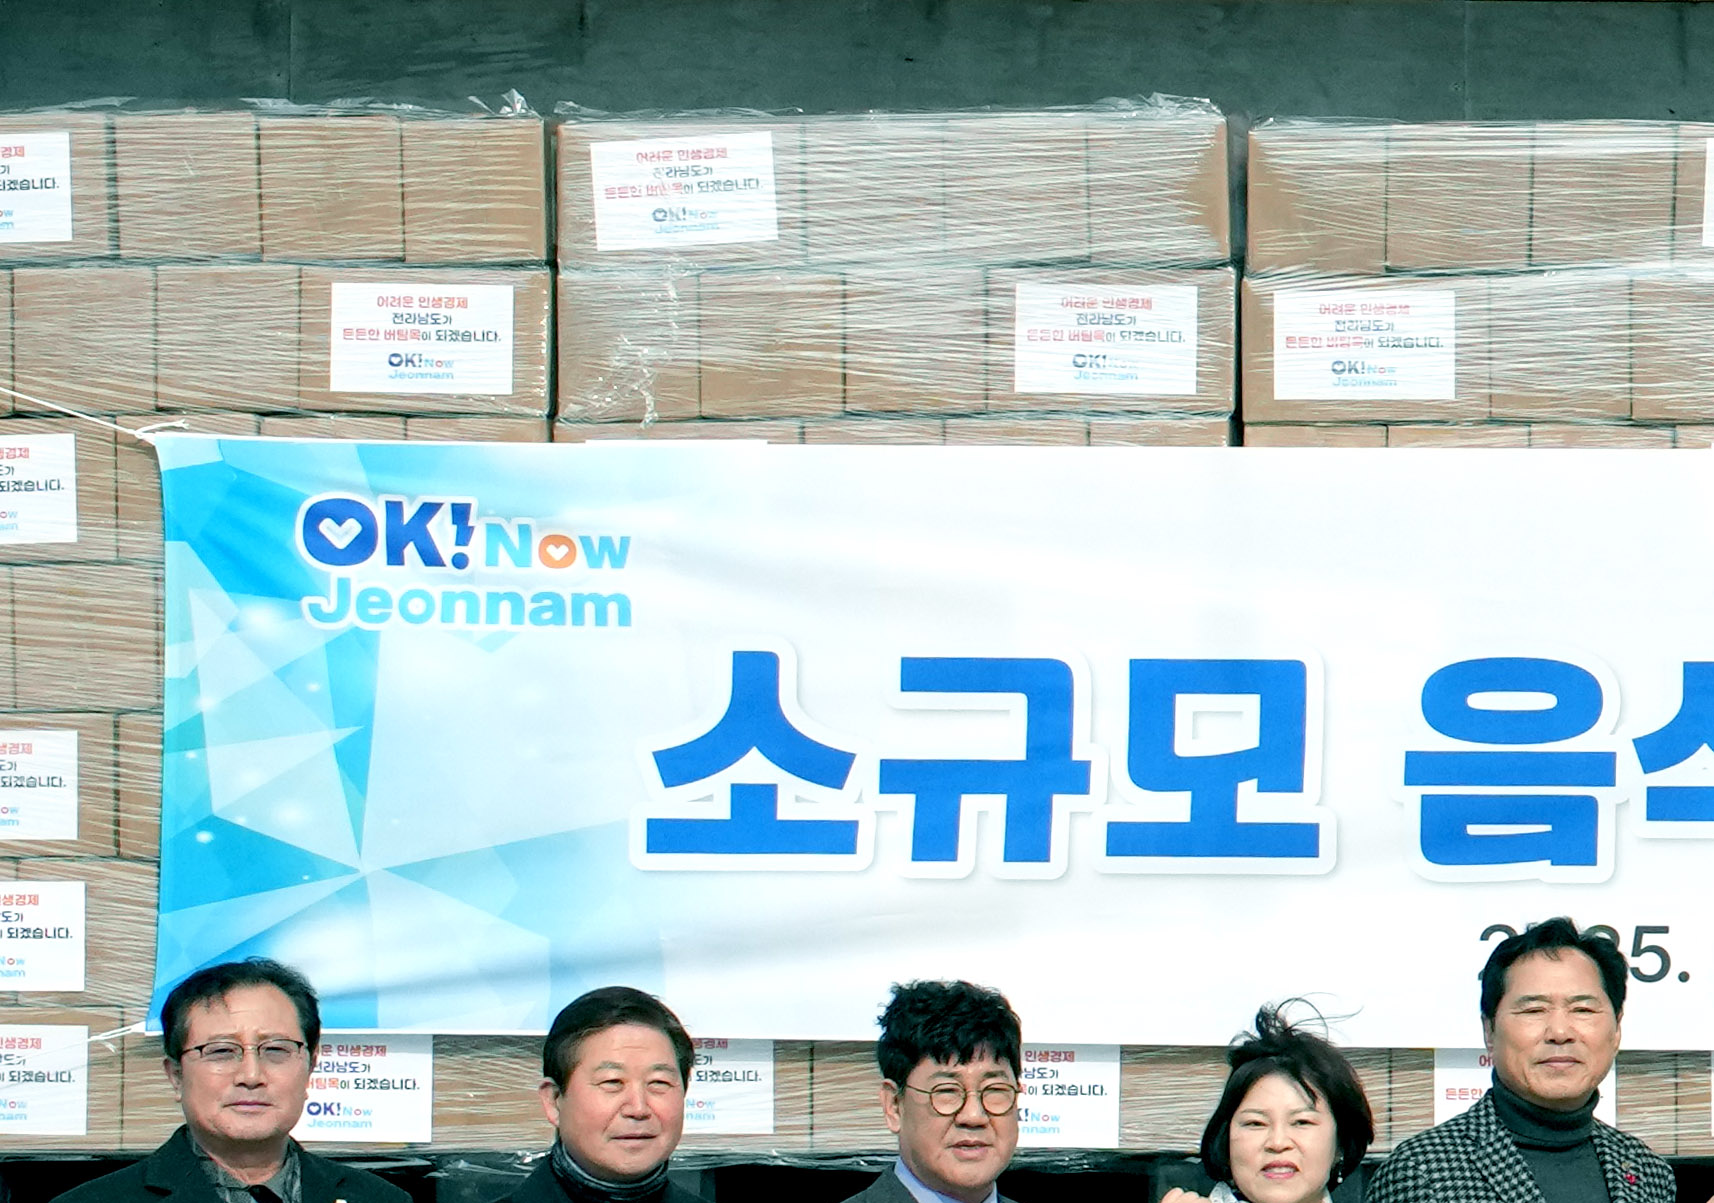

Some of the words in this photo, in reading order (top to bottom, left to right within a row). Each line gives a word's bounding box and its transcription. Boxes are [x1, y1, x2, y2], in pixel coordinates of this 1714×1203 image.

[376, 296, 413, 308] 어려운
[418, 297, 468, 309] 민생경제
[392, 313, 452, 326] 전라남도가
[343, 329, 379, 340] 든든한
[383, 330, 431, 341] 버팀목이
[434, 330, 501, 343] 되겠습니다.
[303, 498, 475, 570] OK!
[485, 523, 631, 569] Now
[307, 577, 632, 627] Jeonnam
[646, 651, 1319, 862] 소규모
[0, 894, 39, 906] 생경제
[7, 927, 73, 940] 되겠습니다.
[338, 1045, 387, 1058] 민생경제
[1026, 1050, 1075, 1064] 민생경제
[9, 1071, 75, 1084] 되겠습니다.
[1023, 1066, 1060, 1079] 남도가
[354, 1078, 420, 1092] 되겠습니다.
[1041, 1084, 1108, 1098] 되겠습니다.
